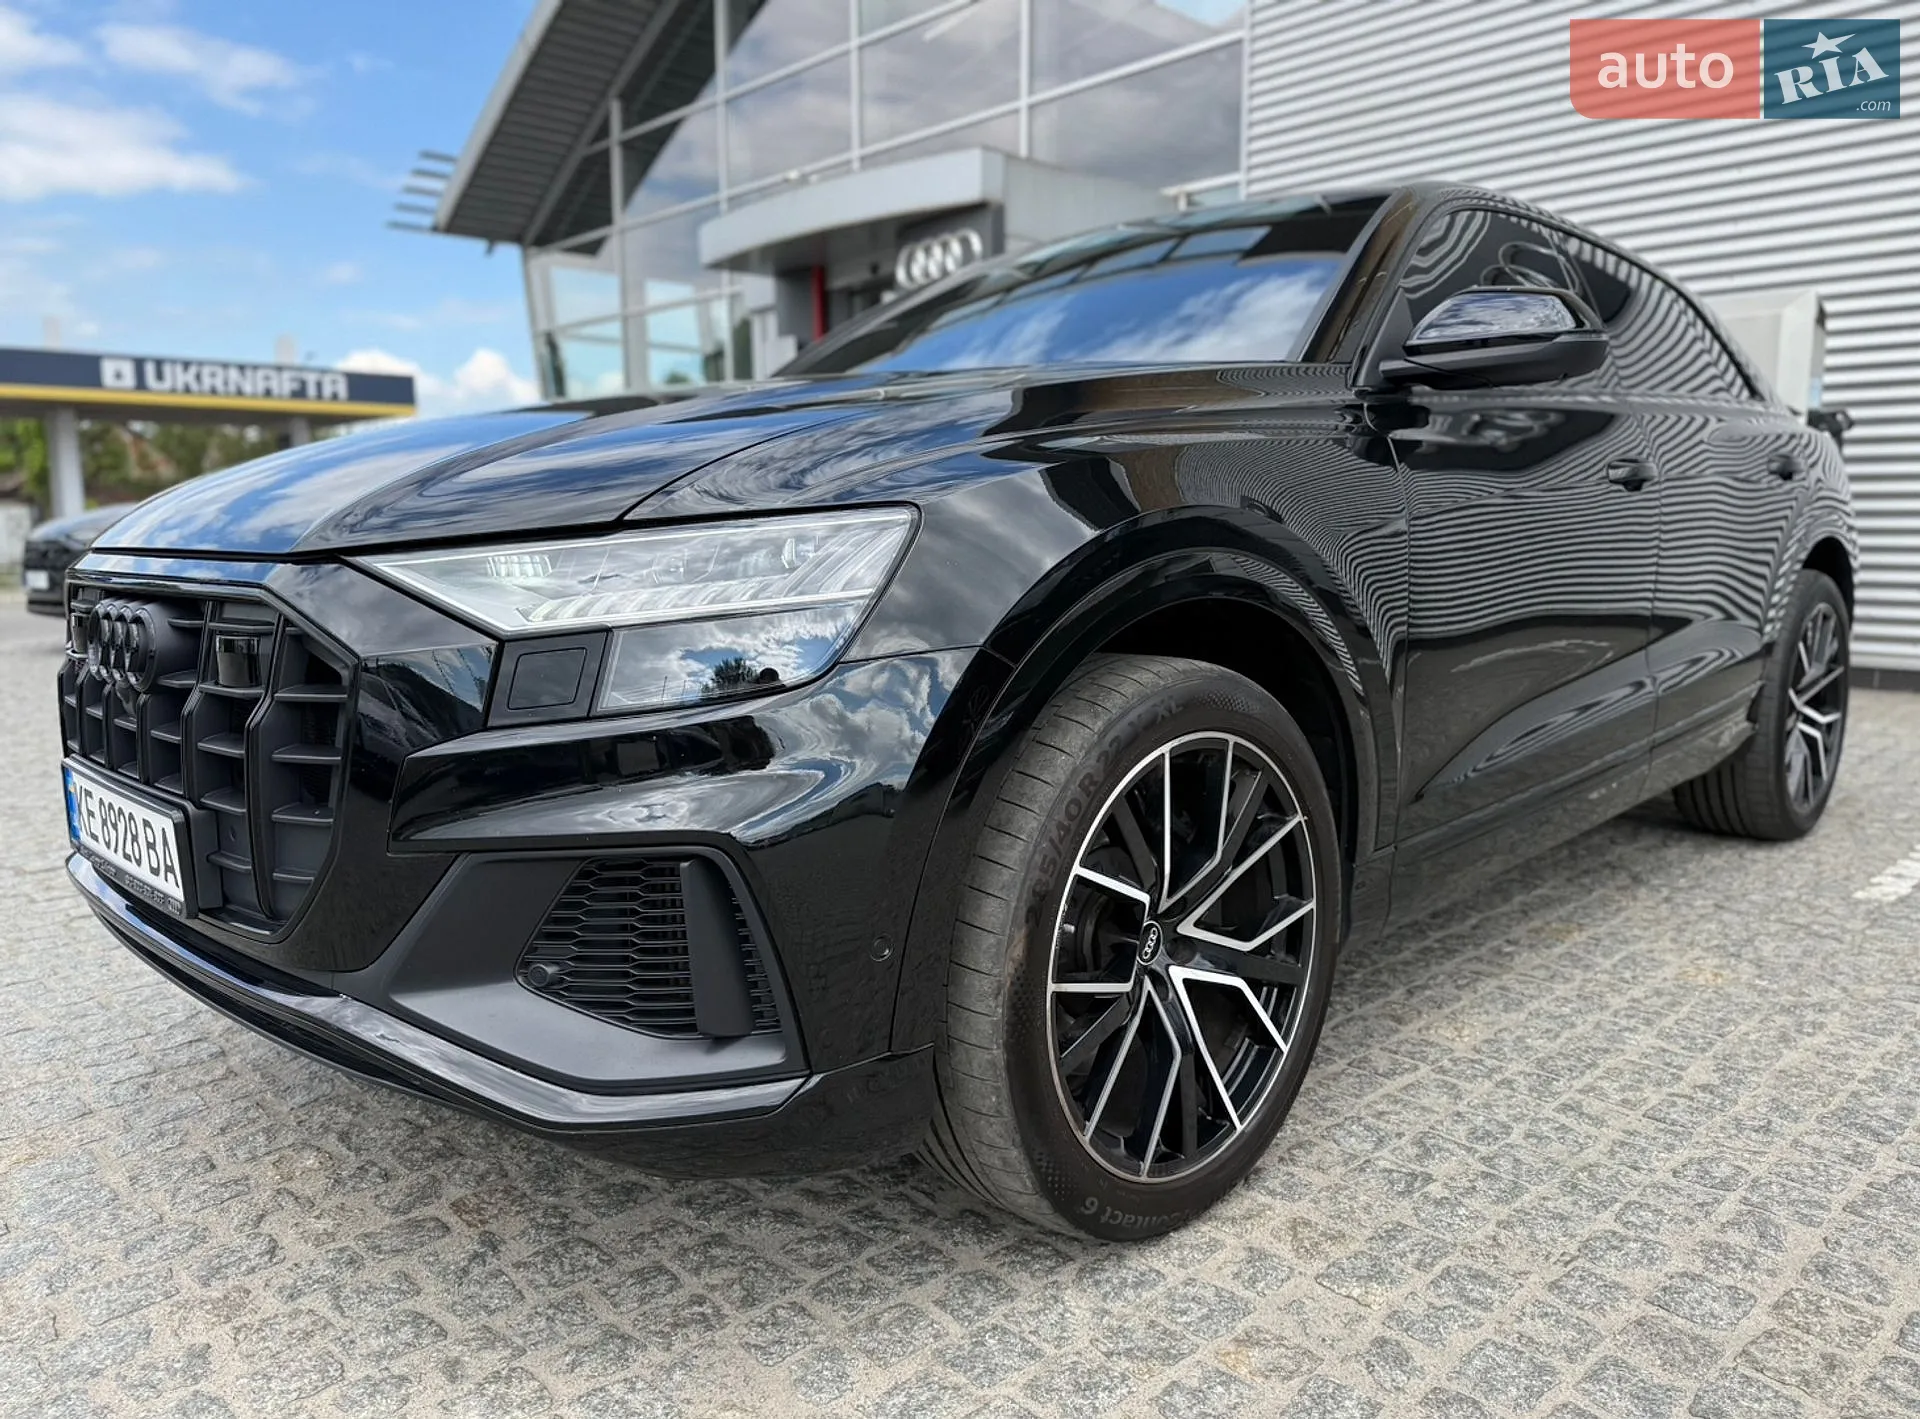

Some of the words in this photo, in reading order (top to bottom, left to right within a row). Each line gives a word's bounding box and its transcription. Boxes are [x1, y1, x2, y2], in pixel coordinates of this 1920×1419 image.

[143, 359, 349, 402] UKRNAFTA
[99, 796, 142, 868] 8928
[142, 817, 180, 889] BA
